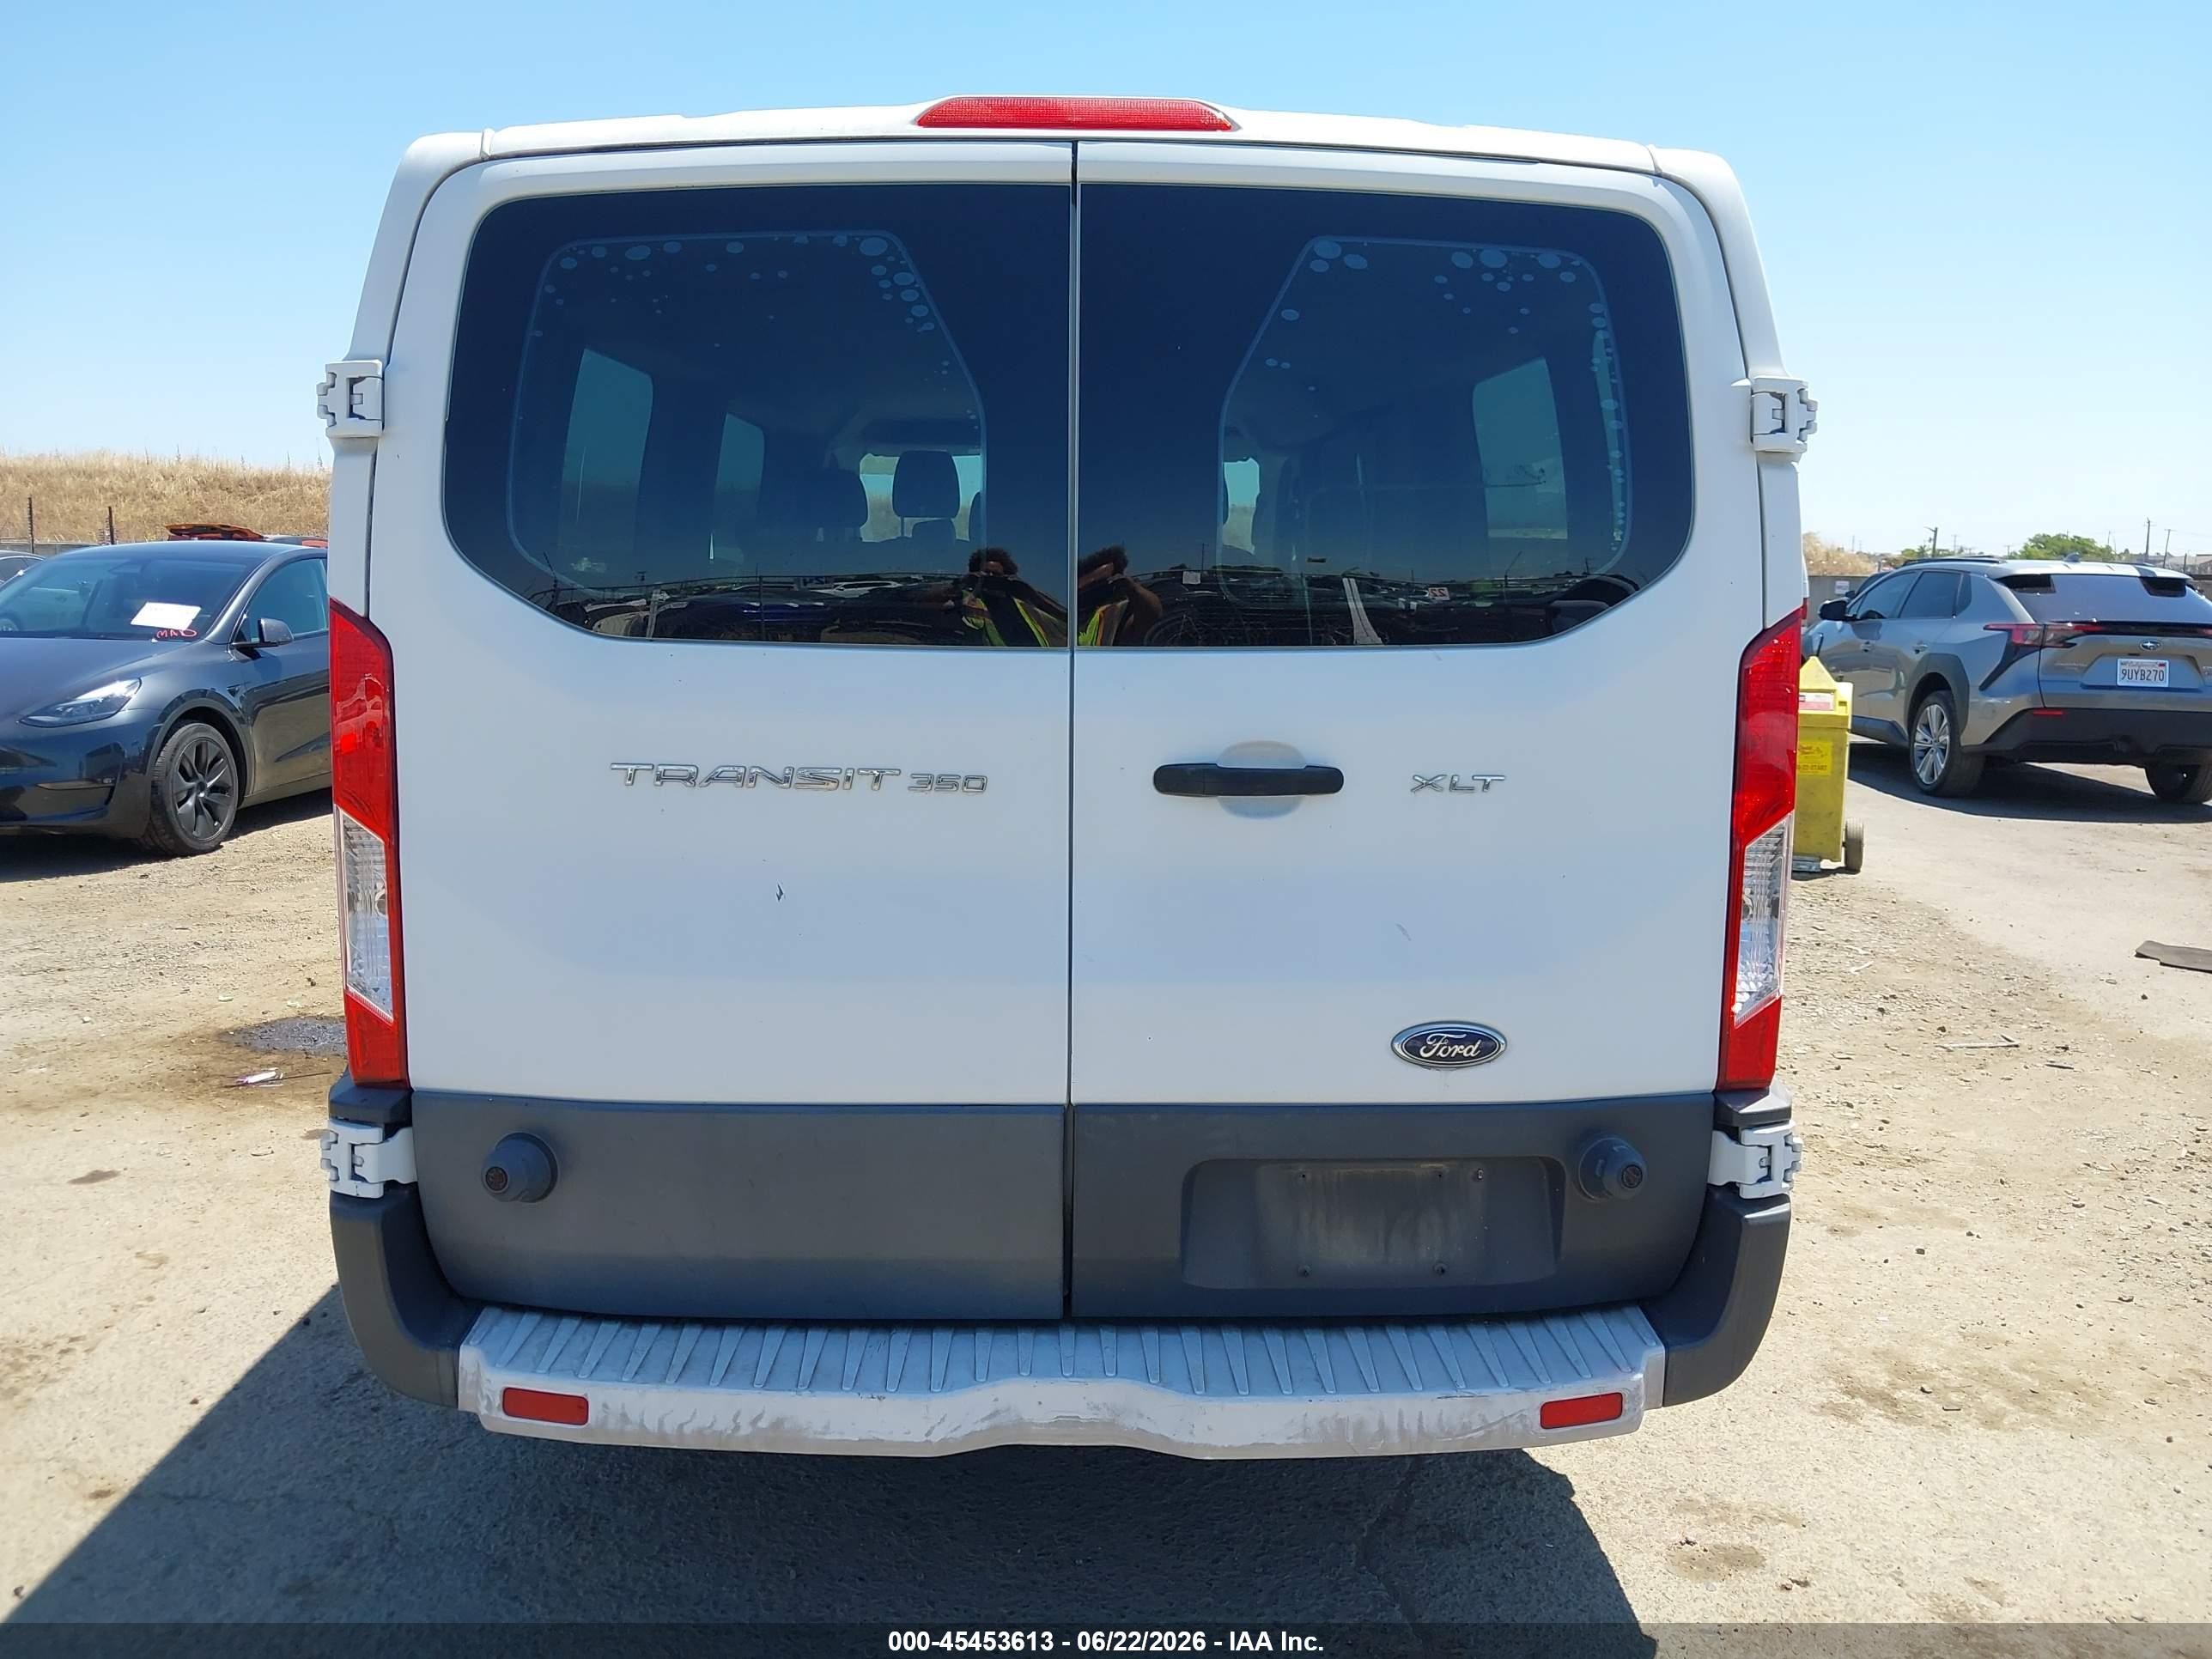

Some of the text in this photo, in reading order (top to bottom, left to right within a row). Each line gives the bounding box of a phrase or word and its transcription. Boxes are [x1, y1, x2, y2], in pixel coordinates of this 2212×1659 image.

[2121, 669, 2165, 682] 9UYB270
[610, 762, 988, 793] TRANSIT 350
[1410, 774, 1506, 794] XLT
[1419, 1032, 1481, 1059] Ford
